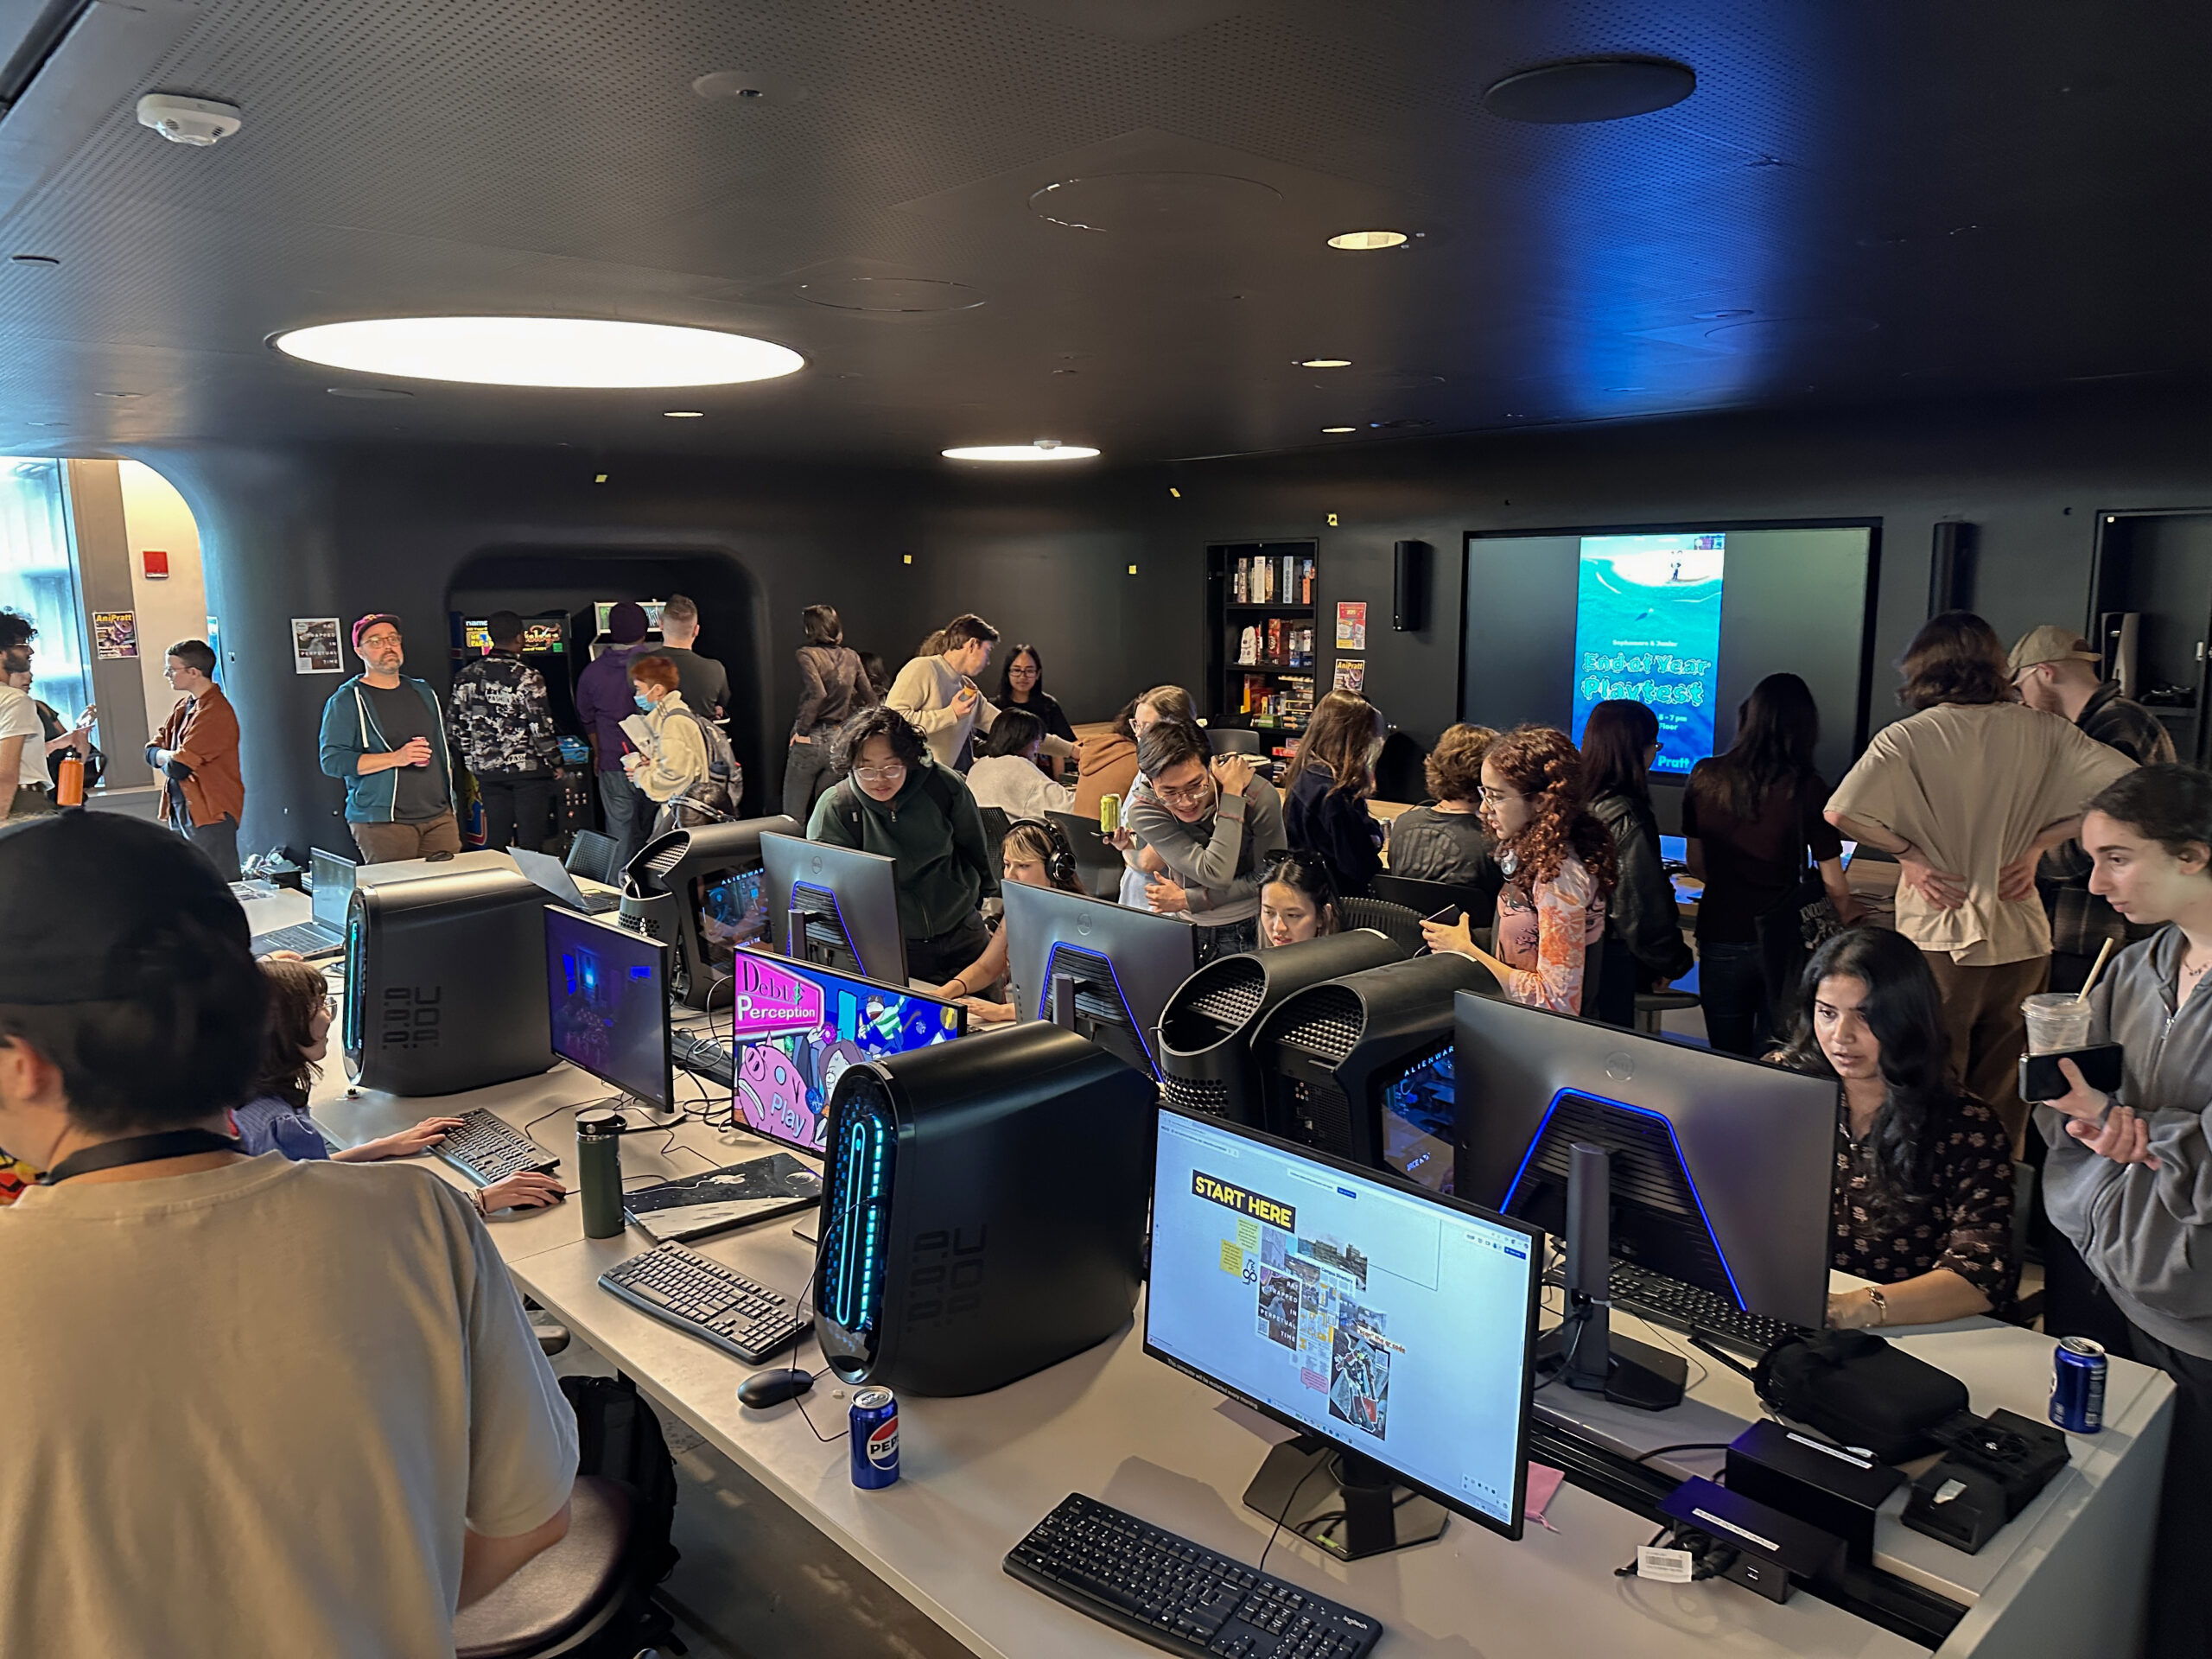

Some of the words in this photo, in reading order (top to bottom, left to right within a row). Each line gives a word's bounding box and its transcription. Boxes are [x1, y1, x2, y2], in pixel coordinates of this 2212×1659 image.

[1582, 652, 1624, 673] End
[1627, 652, 1653, 674] of
[1655, 654, 1711, 676] Year
[1581, 676, 1704, 707] Playtest
[1658, 755, 1689, 768] Pratt
[737, 995, 815, 1021] Perception
[771, 1091, 806, 1138] Play
[1196, 1176, 1245, 1209] START
[1248, 1196, 1293, 1229] HERE
[1260, 1309, 1296, 1329] PERPETUAL
[1281, 1331, 1295, 1342] TIME
[1393, 1344, 1405, 1354] code
[870, 1440, 899, 1454] PEP
